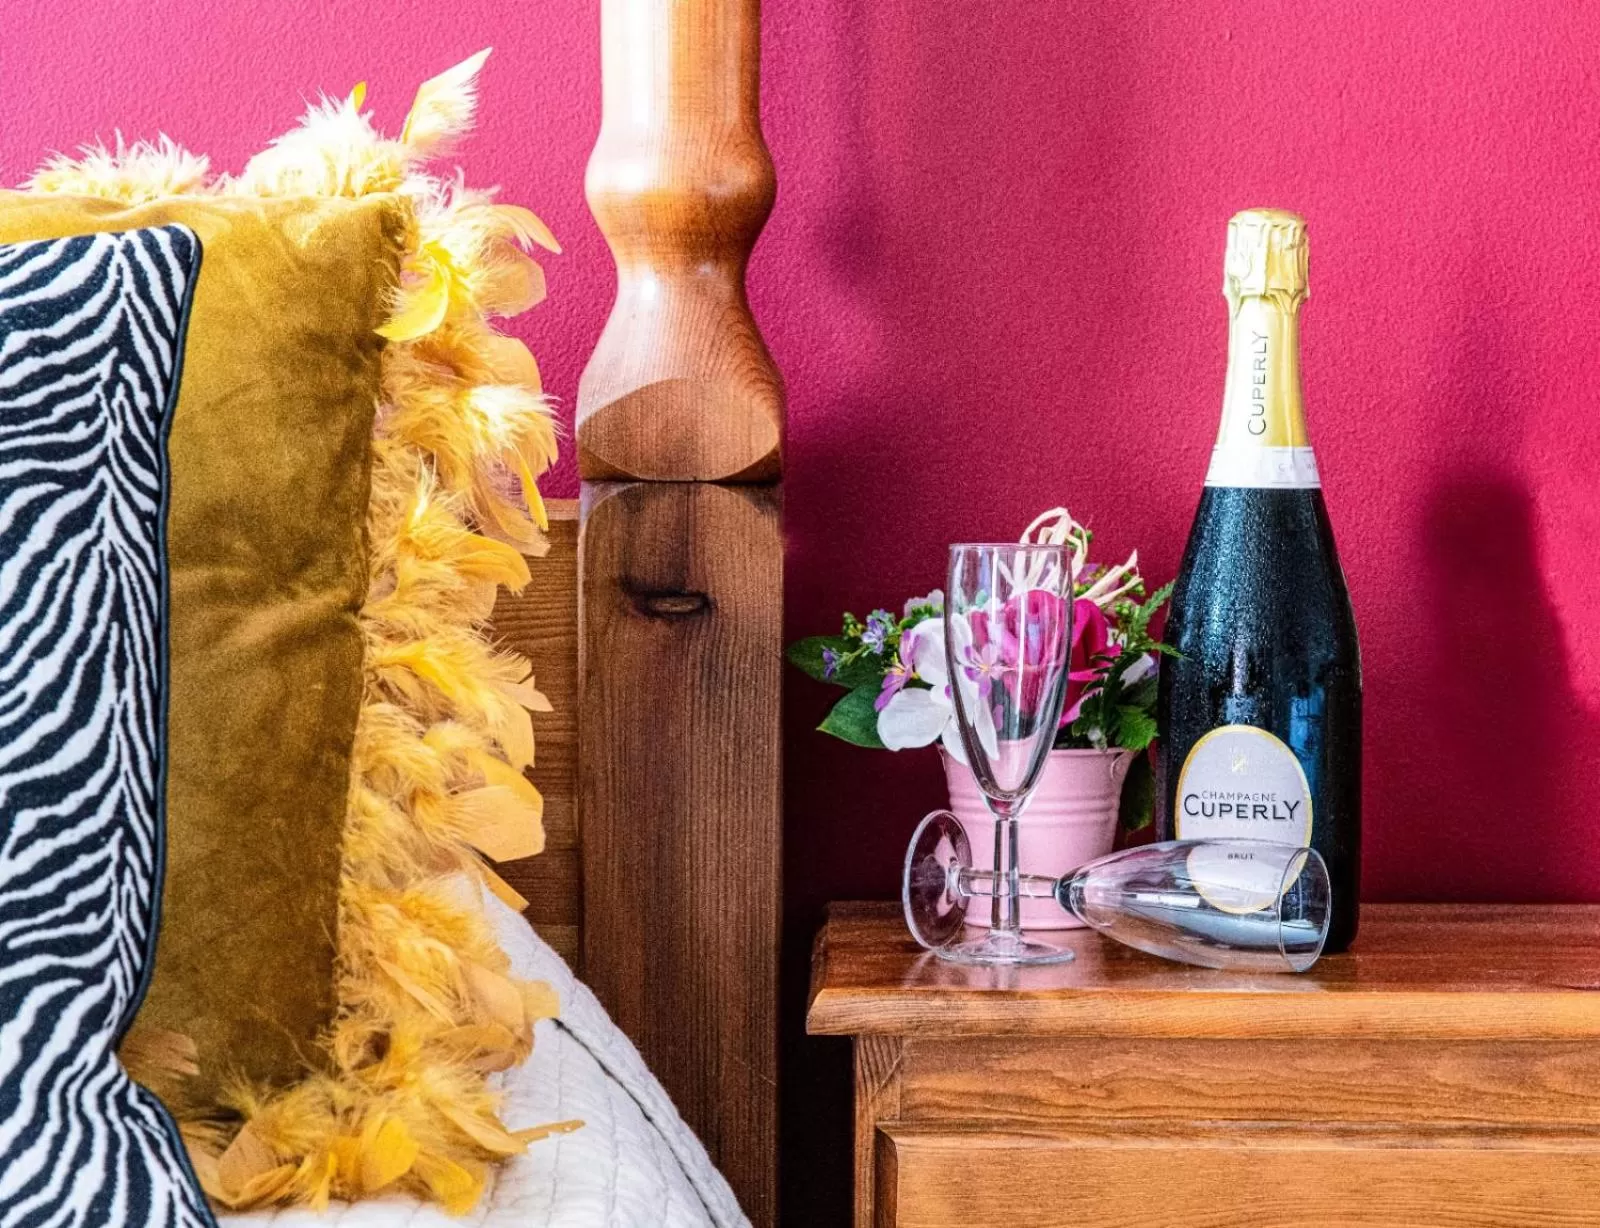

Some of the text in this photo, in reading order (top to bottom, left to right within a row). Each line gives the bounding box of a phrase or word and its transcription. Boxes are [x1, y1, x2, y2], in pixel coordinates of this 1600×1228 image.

[1248, 331, 1268, 435] CUPERLY
[1184, 794, 1300, 820] CUPERLY
[1202, 790, 1277, 802] CHAMPAGNE
